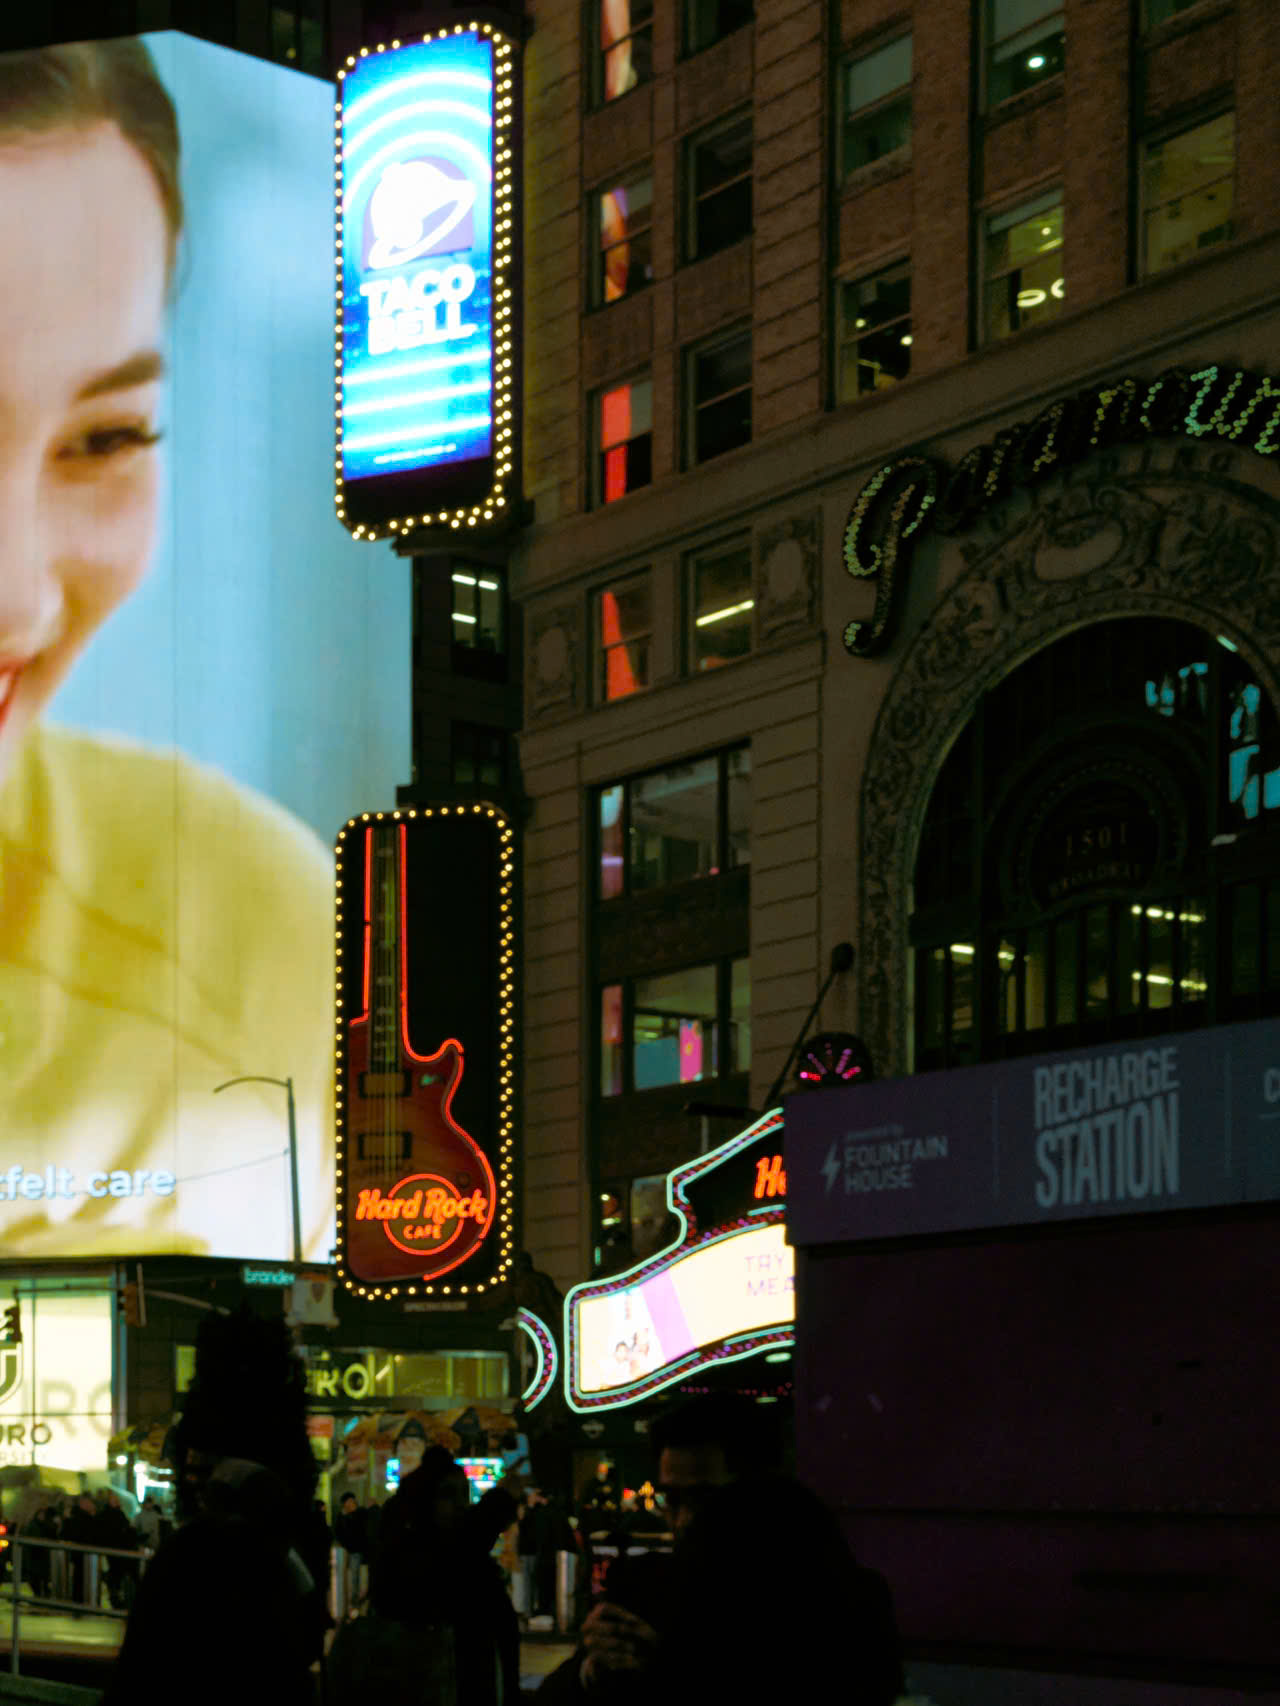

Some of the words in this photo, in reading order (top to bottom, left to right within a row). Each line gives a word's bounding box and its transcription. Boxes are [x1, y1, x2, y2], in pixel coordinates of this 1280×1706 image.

[360, 264, 475, 318] TACO
[368, 301, 477, 355] BELL
[1034, 1047, 1181, 1131] RECHARGE
[844, 1136, 949, 1168] FOUNTAIN
[1035, 1091, 1181, 1208] STATION
[87, 1167, 177, 1199] care
[844, 1163, 913, 1194] HOUSE
[355, 1188, 424, 1221] Hard
[423, 1187, 488, 1225] Rock
